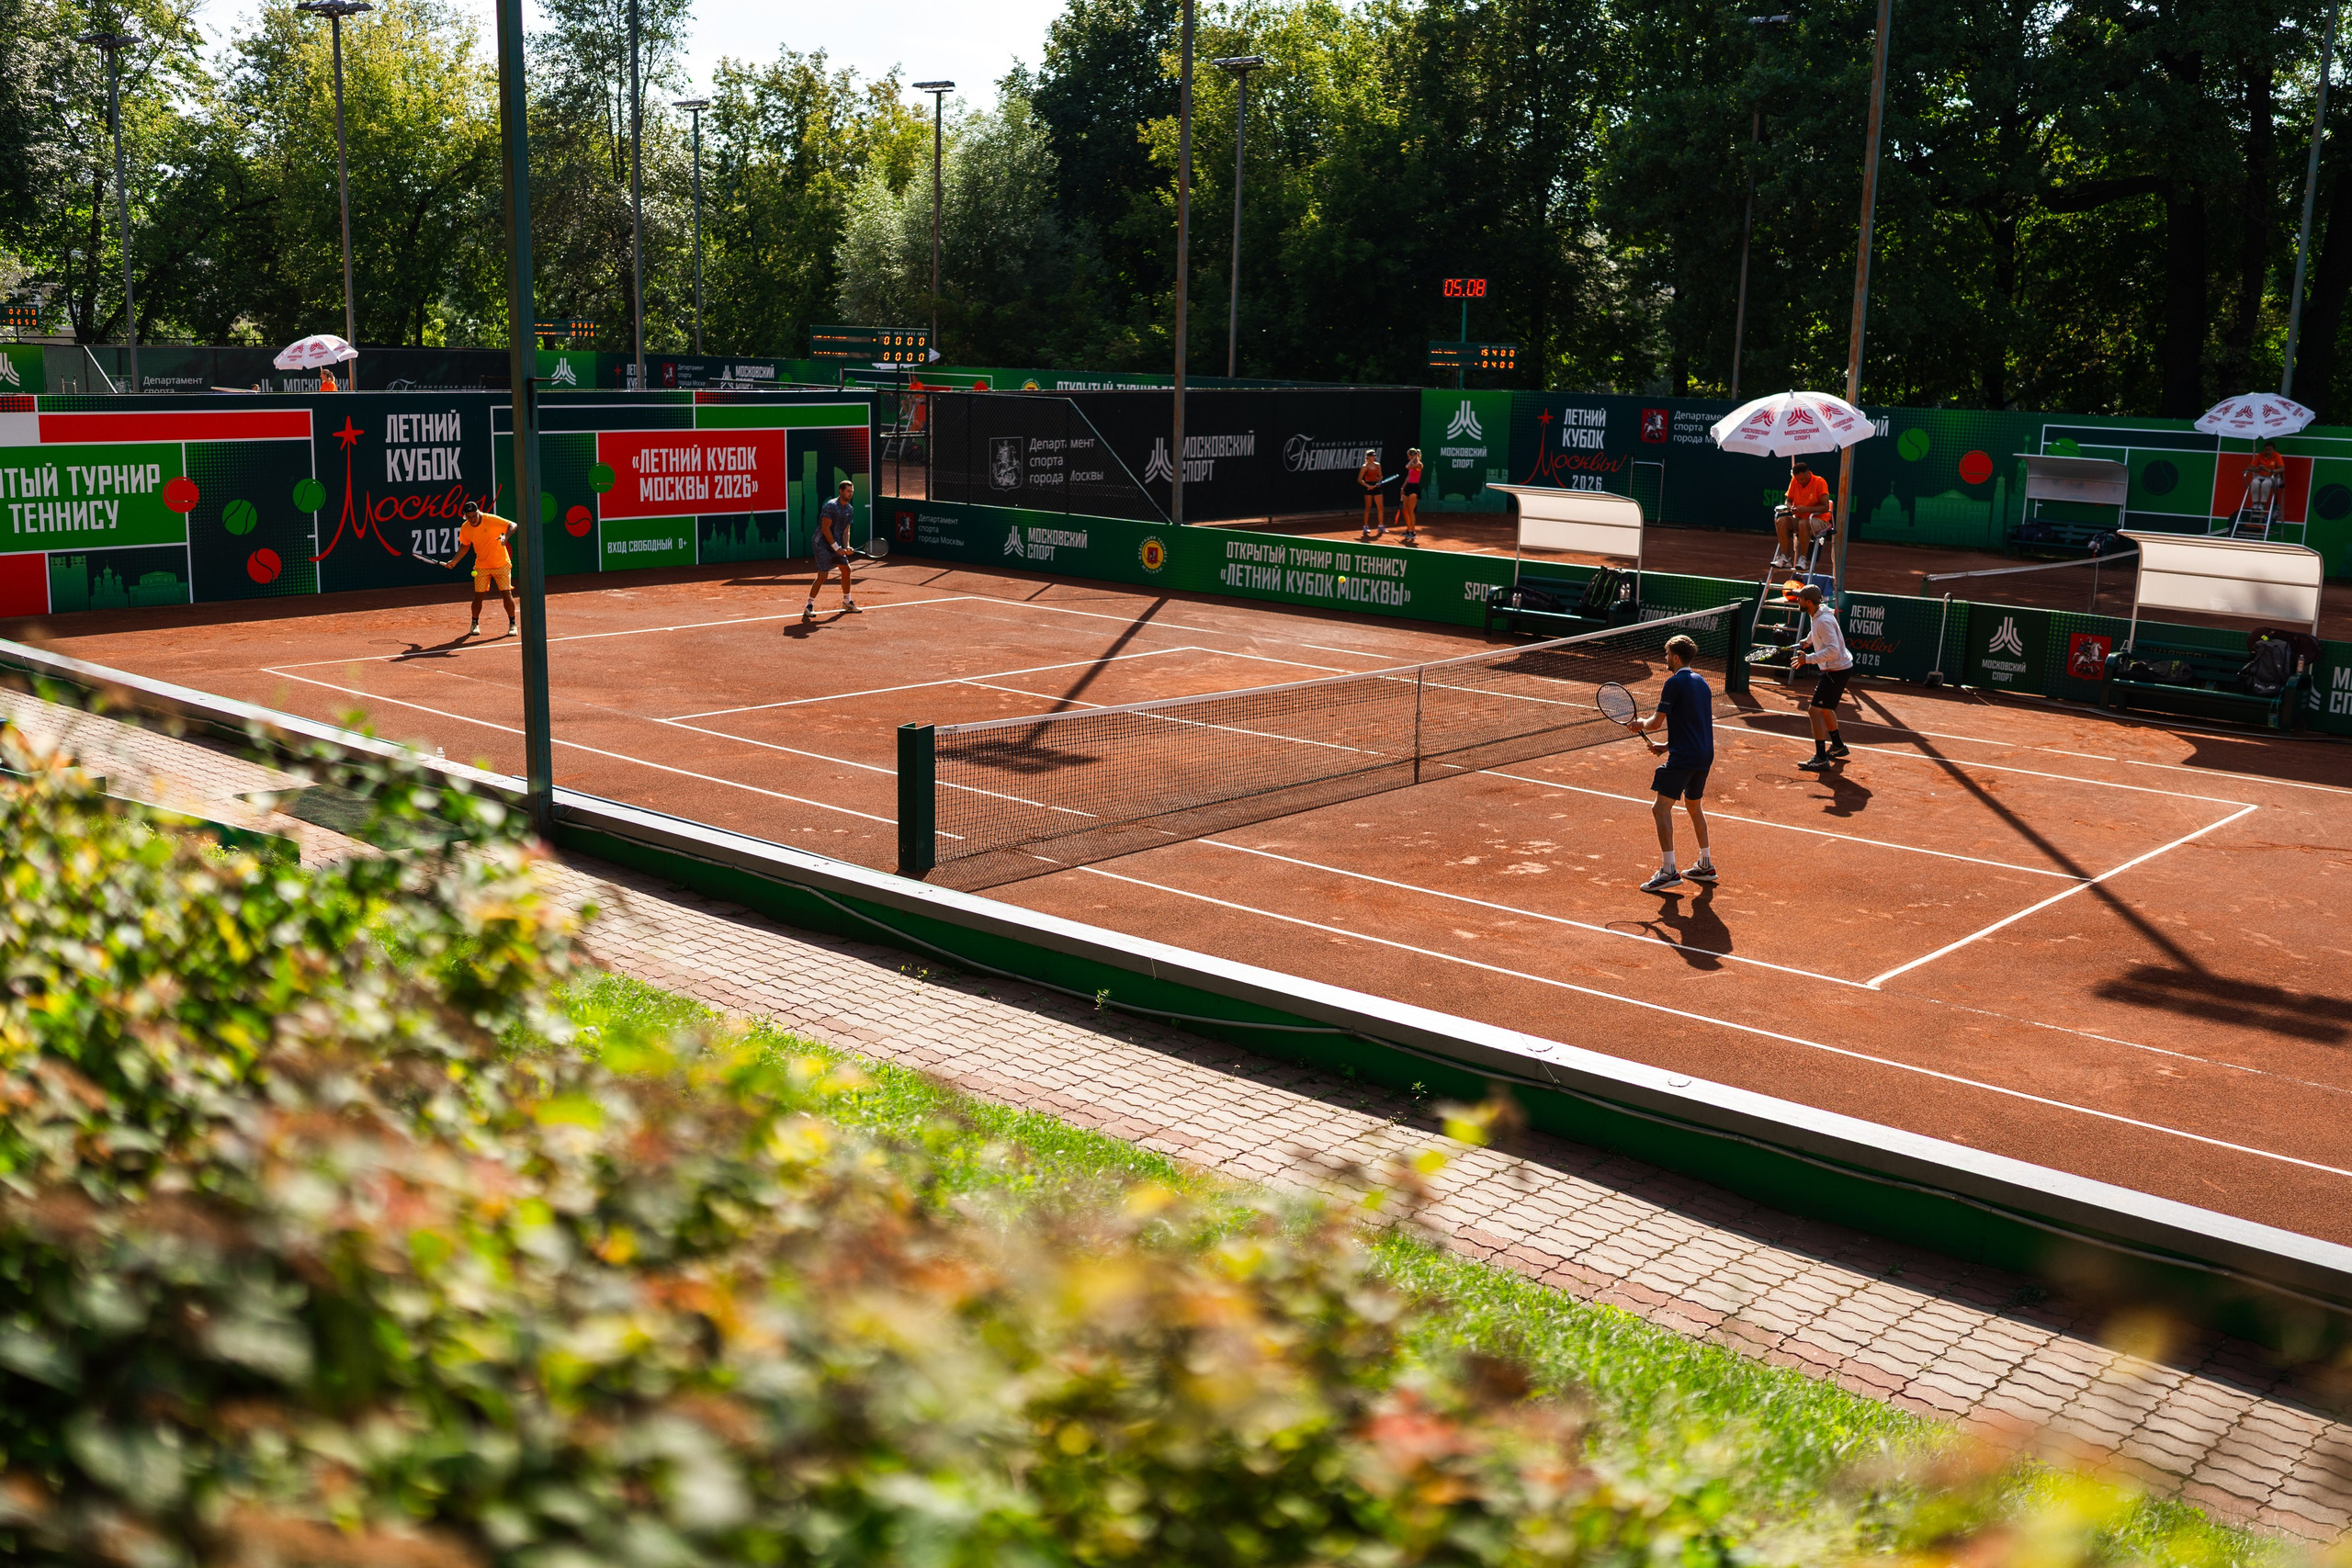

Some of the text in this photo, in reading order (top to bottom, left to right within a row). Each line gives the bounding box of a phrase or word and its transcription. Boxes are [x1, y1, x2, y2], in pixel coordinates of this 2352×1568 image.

[1444, 279, 1486, 297] 05.08
[884, 336, 925, 346] 0 0 0 0
[884, 352, 925, 362] 0 0 0 0
[735, 364, 775, 378] МОСКОВСКИЙ
[142, 376, 203, 387] Департамент
[283, 378, 349, 392] МОСКОКИ
[1564, 408, 1606, 427] ЛЕТНИЙ
[1674, 411, 1724, 422] Департаме
[385, 409, 460, 443] ЛЕТНИЙ
[1674, 423, 1703, 433] спорта
[1784, 427, 1820, 436] МОСКОВСКИЙ
[1029, 438, 1095, 453] Департмент
[1563, 429, 1604, 449] КУБОК
[1673, 434, 1703, 445] города
[632, 445, 757, 473] «ЛЕТНИЙ КУБОК
[1440, 446, 1487, 458] МОСКОВСКИЙ
[386, 447, 462, 482] КУБОК
[1029, 457, 1064, 469] спорта
[1452, 458, 1474, 469] СПОРТ
[66, 464, 161, 496] ТУРНИР
[1029, 473, 1064, 486] города
[1571, 475, 1602, 491] 2026
[639, 474, 759, 502] МОСКВЫ 2026»
[7, 500, 119, 534] ТЕННИСУ
[918, 514, 958, 525] Департамент
[918, 525, 939, 534] спорта
[918, 535, 965, 547] города Москвы
[1027, 527, 1088, 549] МОСКОВСКИЙ
[607, 537, 687, 554] ВХОД СВОБОДНЫЙ 0+
[1027, 544, 1055, 561] СПОРТ
[1226, 541, 1407, 578] ОТКРЫТЫЙ ТУРНИР ПО ТЕННИСУ
[1220, 563, 1411, 607] «ЛЕТНИЙ КУБОК МОСКВЫ»
[1850, 604, 1884, 620] ЛЕТНИЙ
[1849, 619, 1883, 637] КУБОК
[1844, 636, 1901, 653] осквы
[1856, 652, 1880, 666] 2026
[1981, 659, 2026, 673] МОСКОВСКИЙ
[1992, 671, 2013, 682] СПОРТ
